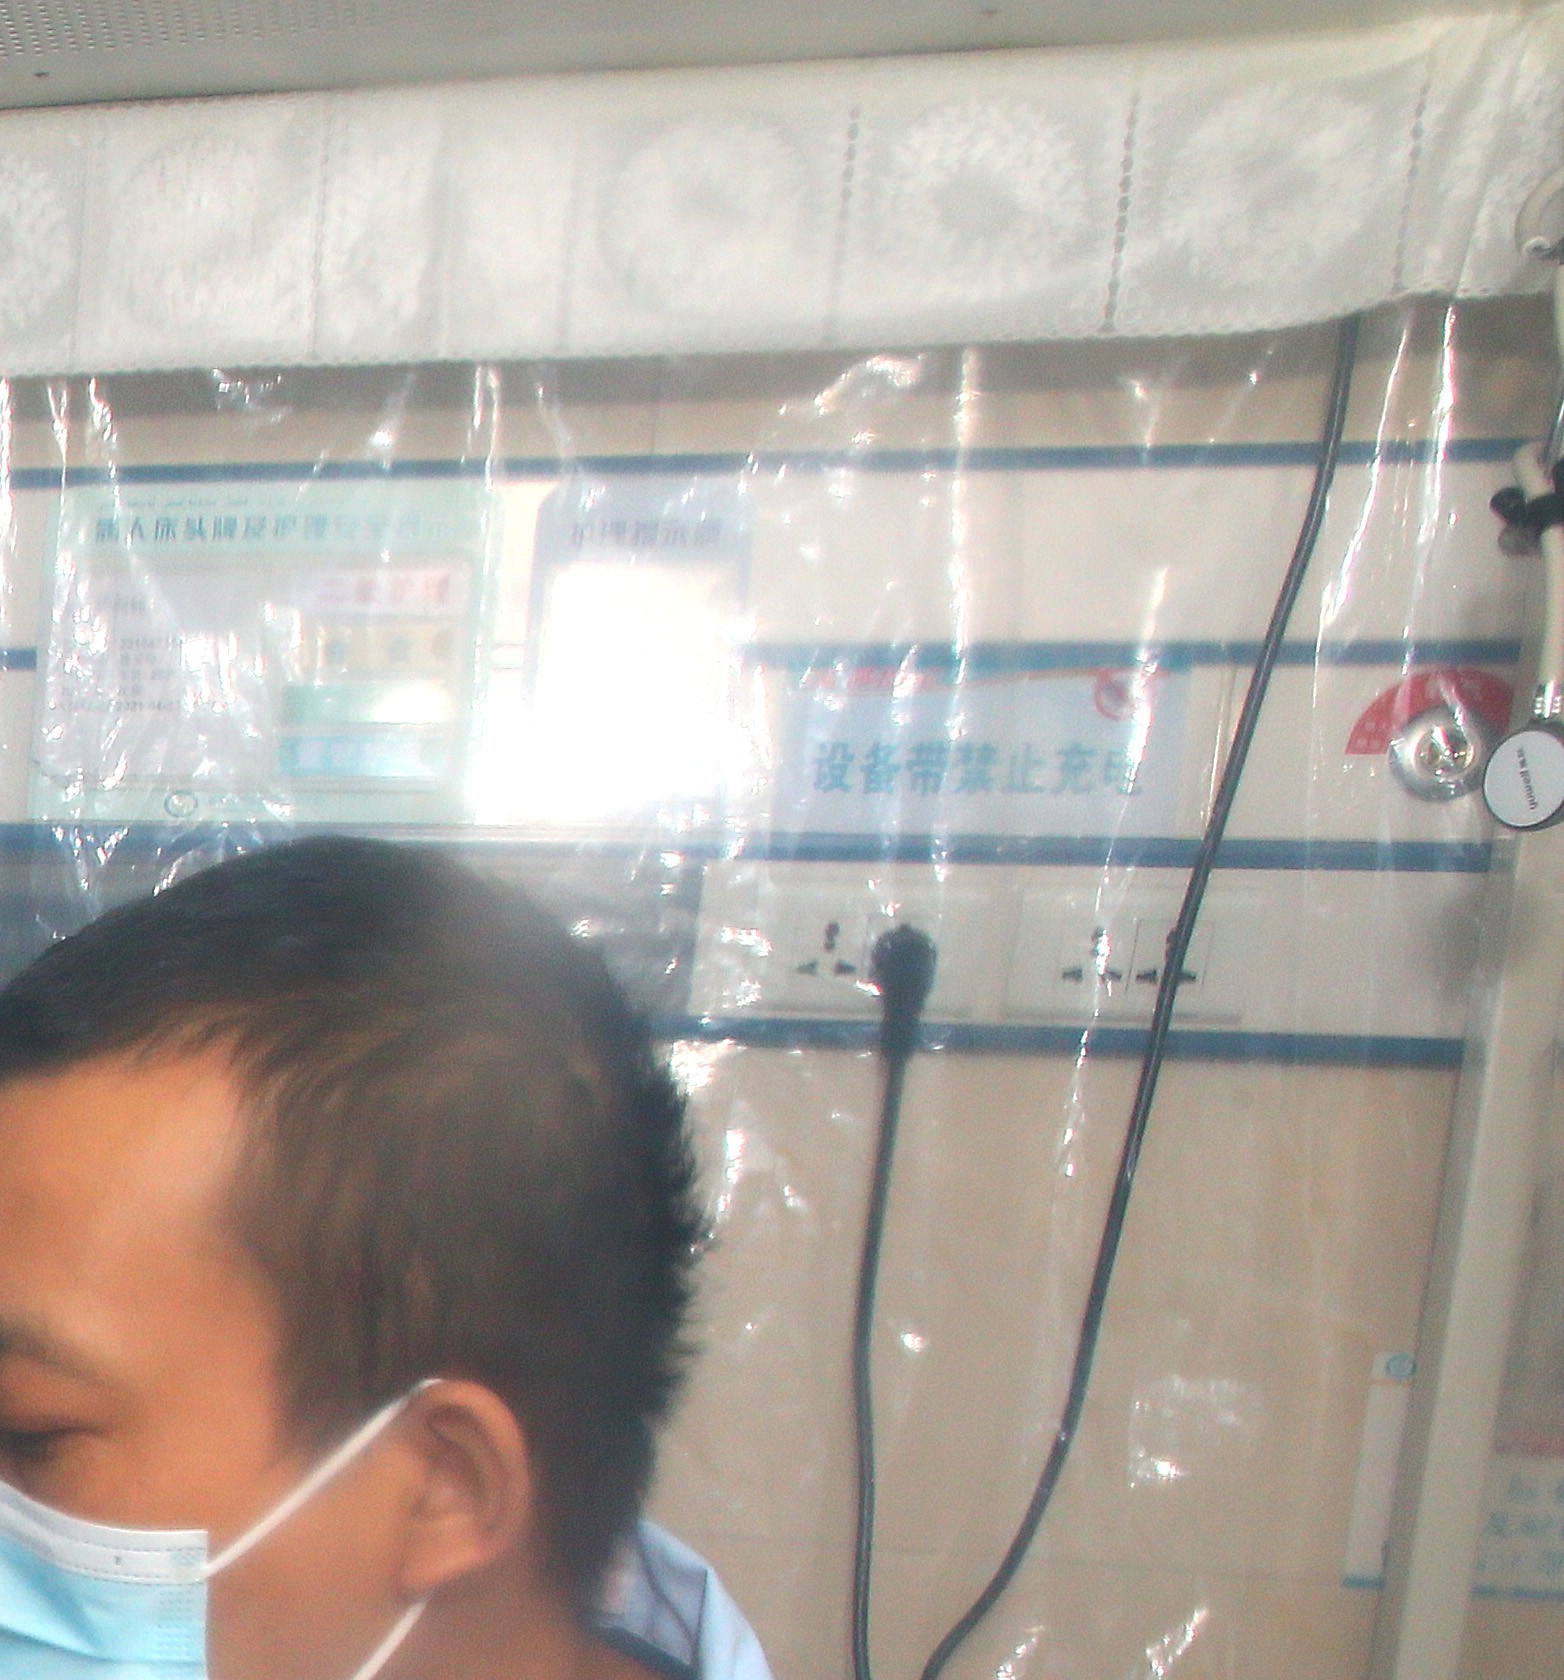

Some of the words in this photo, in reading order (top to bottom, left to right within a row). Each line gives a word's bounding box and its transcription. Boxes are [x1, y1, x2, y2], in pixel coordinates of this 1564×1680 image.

[813, 739, 1144, 796] 设备带禁止充电
